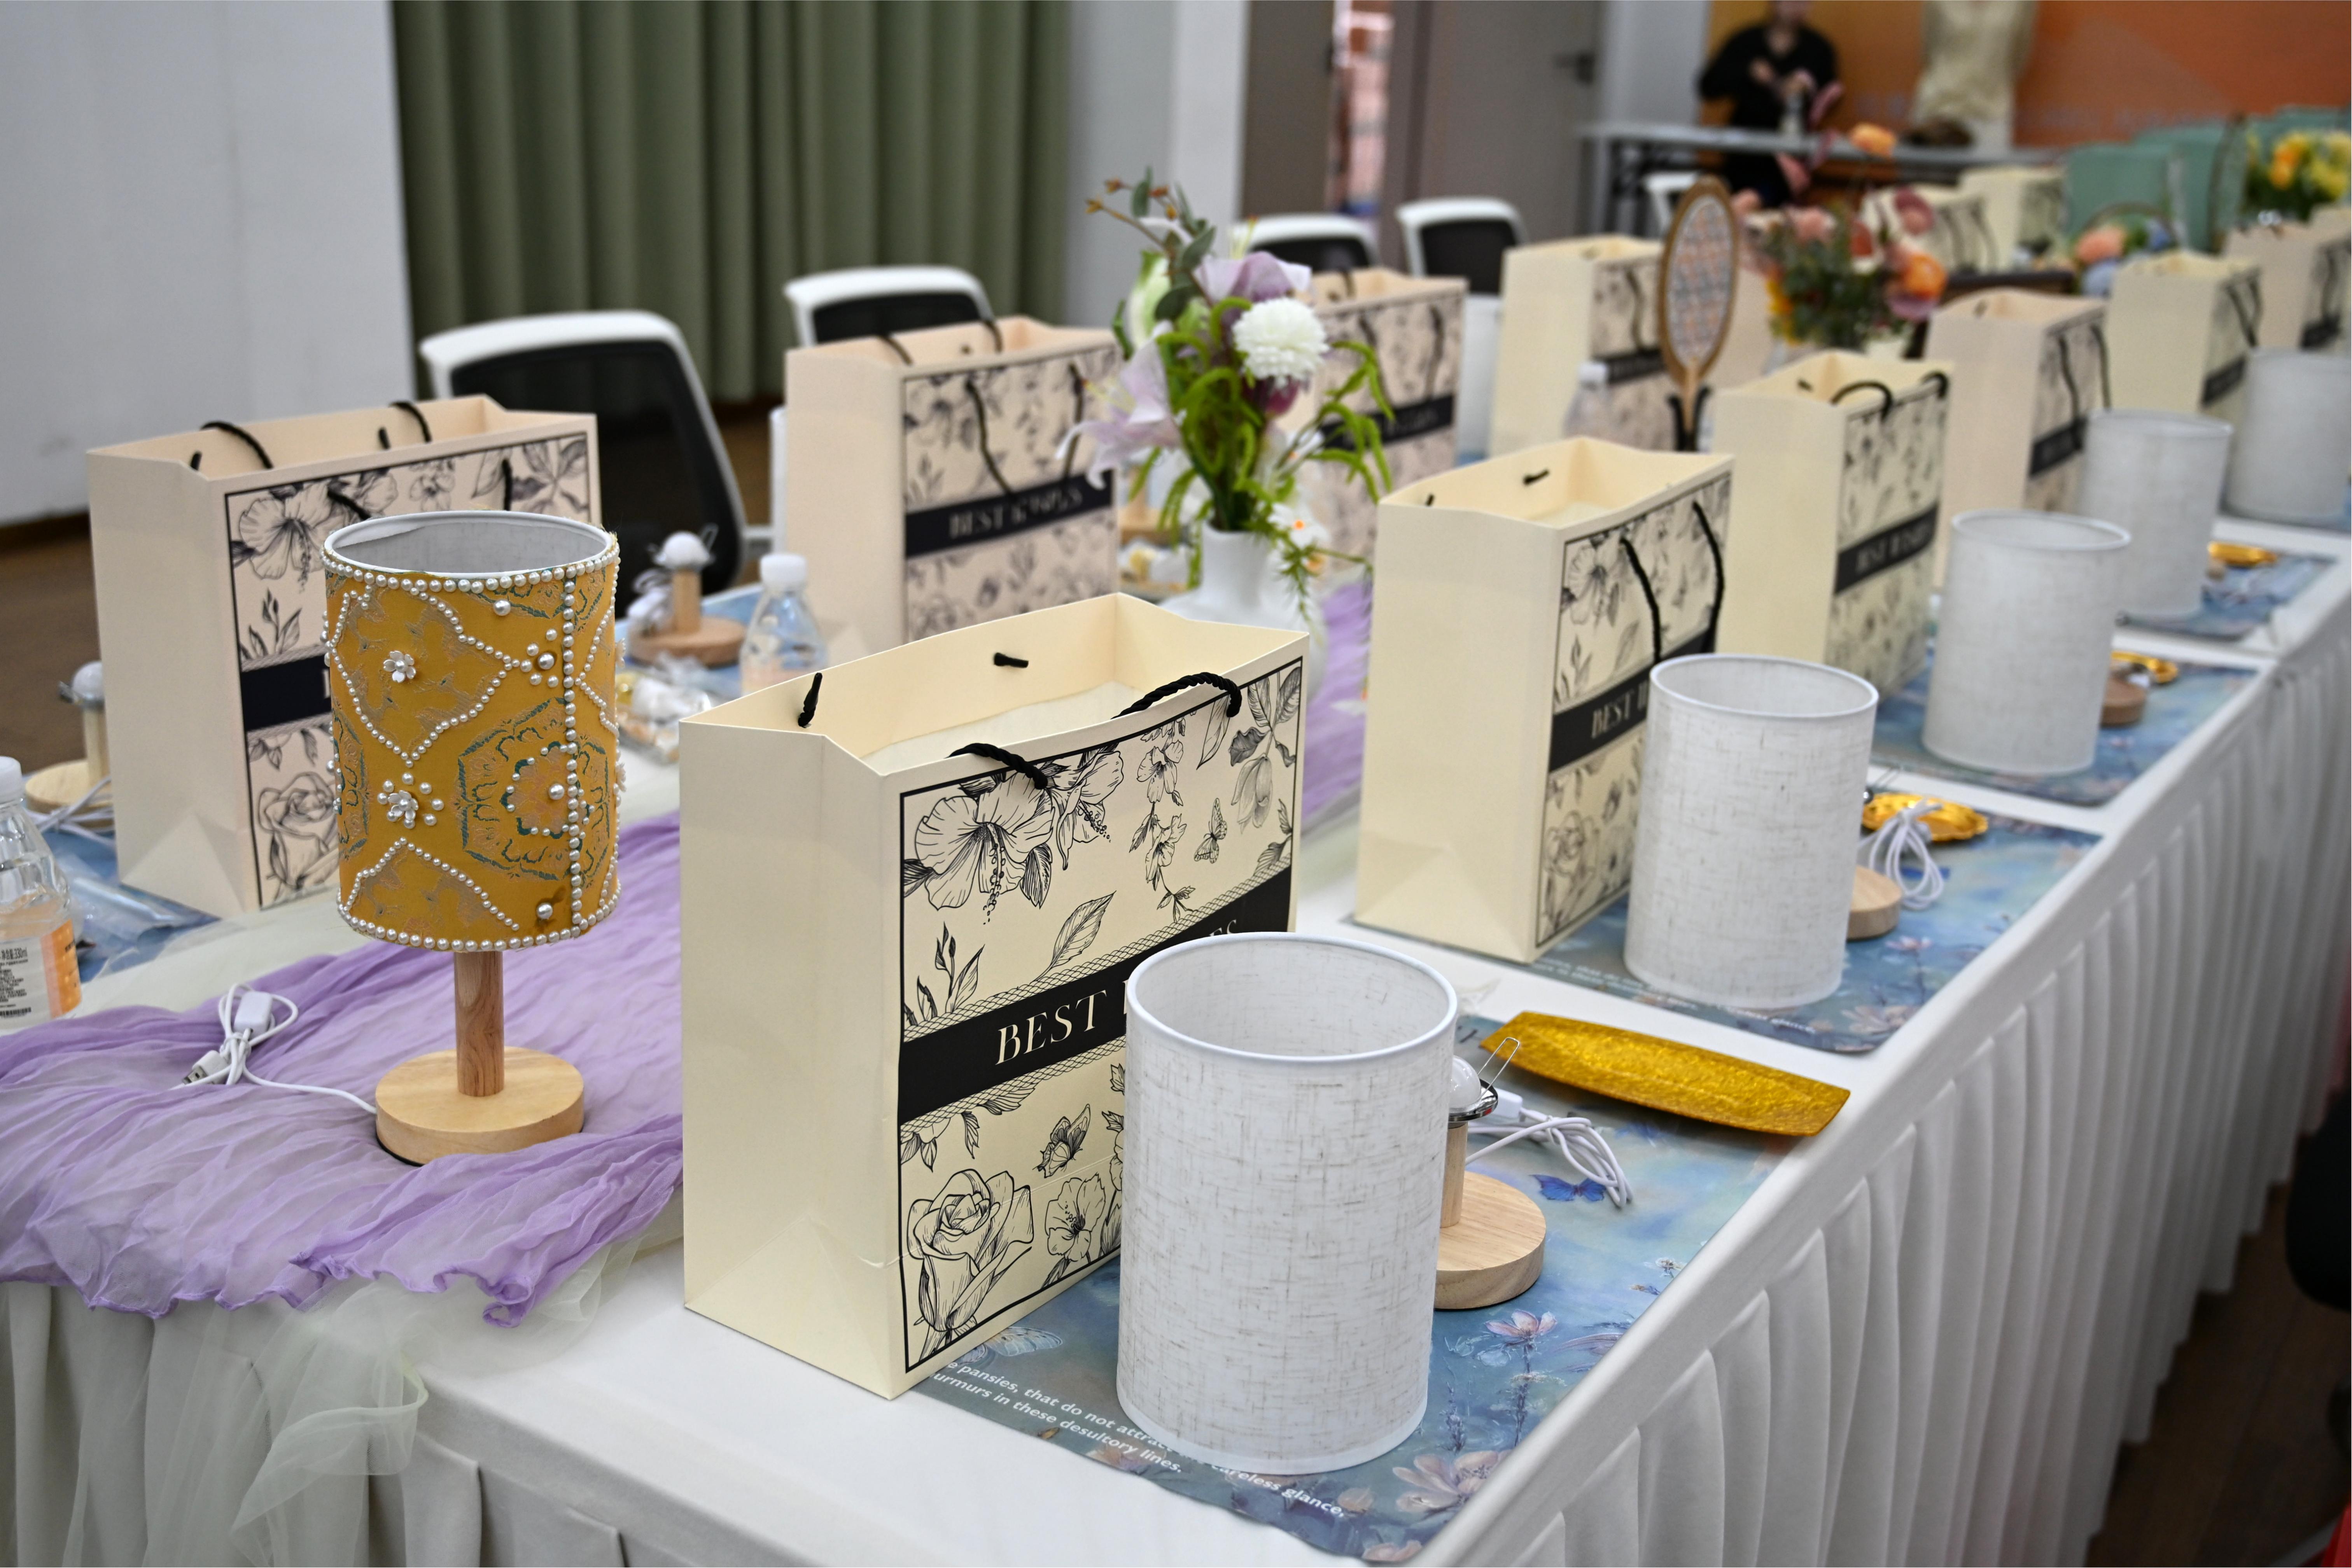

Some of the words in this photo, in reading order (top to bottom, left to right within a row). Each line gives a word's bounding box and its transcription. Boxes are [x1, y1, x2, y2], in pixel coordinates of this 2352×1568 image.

[995, 990, 1107, 1065] BEST
[957, 1365, 1018, 1393] pansies,
[1024, 1388, 1059, 1406] that
[1061, 1403, 1082, 1416] do
[1085, 1412, 1116, 1428] not
[1281, 1488, 1344, 1518] glance,
[993, 1393, 1010, 1405] in
[1013, 1402, 1057, 1423] these
[1059, 1420, 1138, 1455] desultory
[1139, 1449, 1181, 1473] lines.
